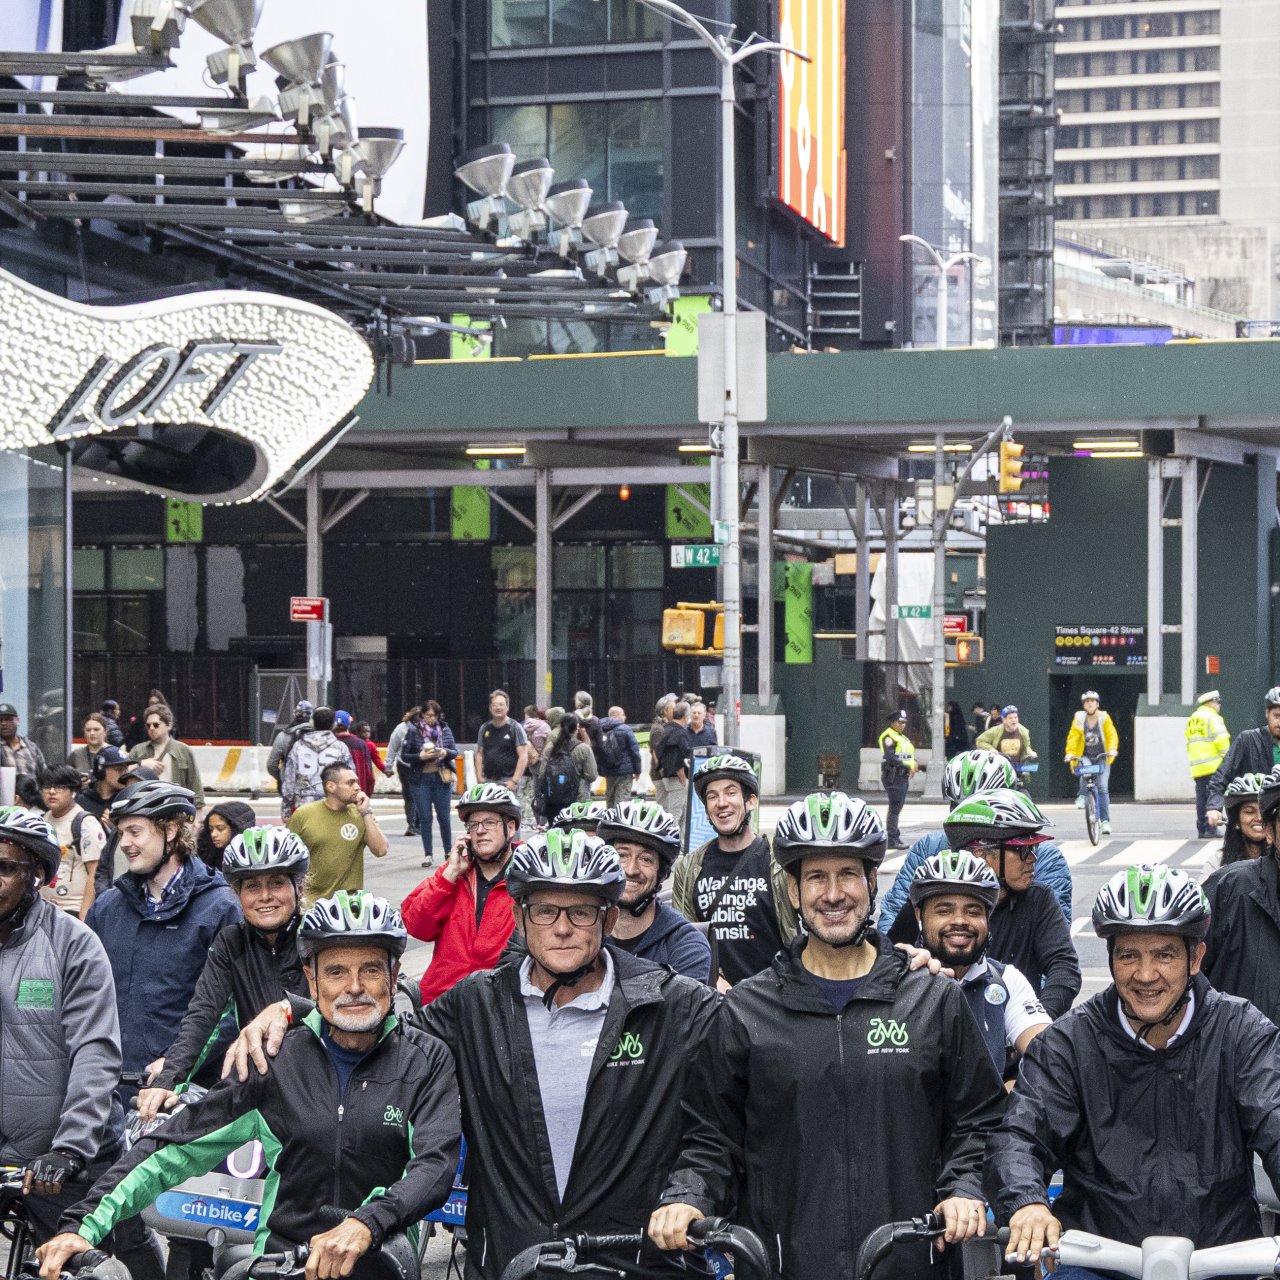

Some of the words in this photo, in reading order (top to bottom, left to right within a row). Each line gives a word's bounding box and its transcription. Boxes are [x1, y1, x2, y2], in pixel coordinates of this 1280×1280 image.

[46, 338, 284, 439] LOFT
[685, 548, 695, 564] W
[697, 548, 710, 563] 42
[910, 607, 921, 617] 42
[1056, 626, 1078, 634] Times
[1080, 626, 1119, 636] Square-42
[1121, 626, 1143, 634] Street
[181, 1200, 208, 1218] citi
[209, 1204, 243, 1222] bike
